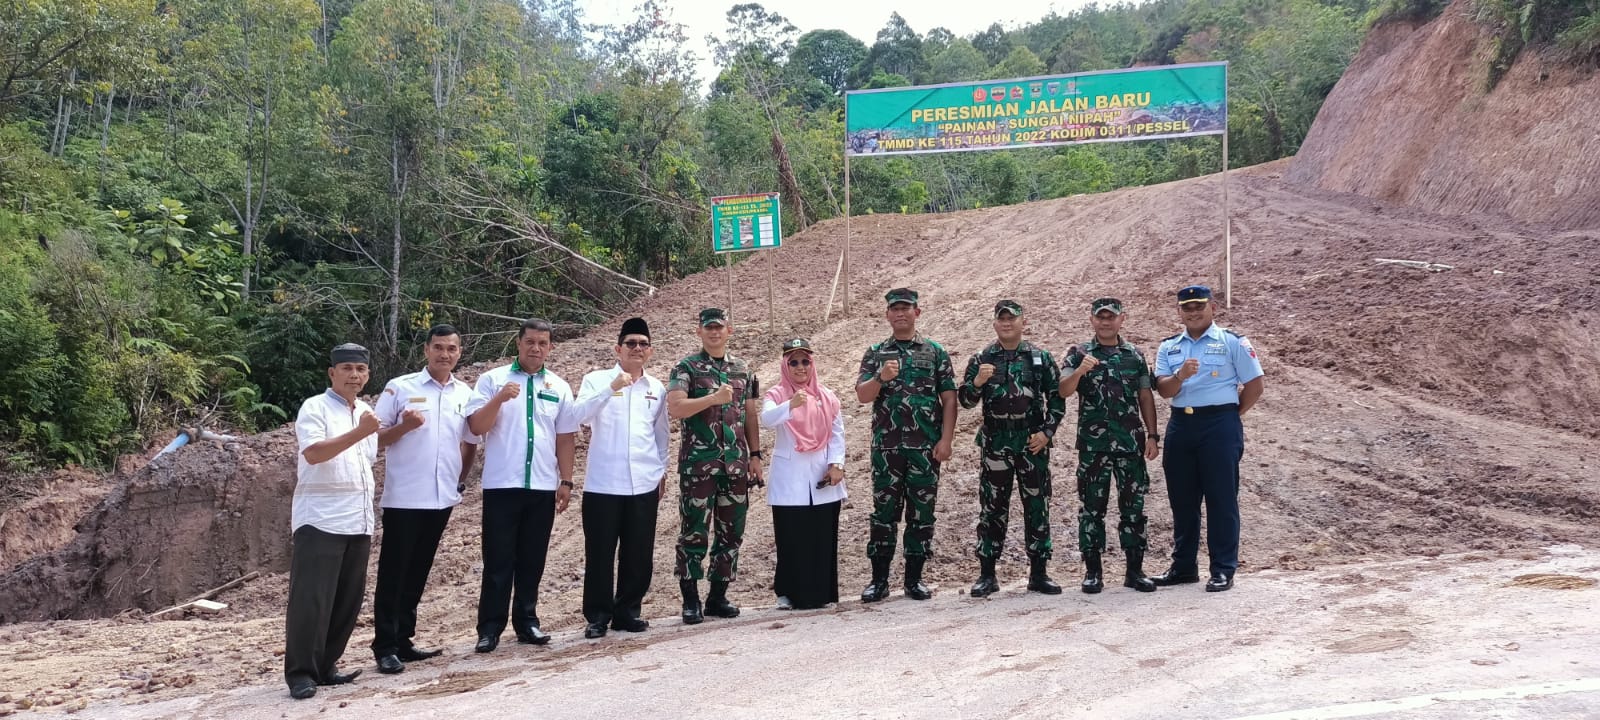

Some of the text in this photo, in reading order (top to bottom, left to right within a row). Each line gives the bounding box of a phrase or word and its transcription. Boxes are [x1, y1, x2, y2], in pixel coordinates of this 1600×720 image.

[911, 91, 1151, 122] PERESMIAN JALAN BARU
[1009, 114, 1064, 129] SUNGAI
[878, 137, 915, 150] TMMD
[918, 137, 936, 148] KE
[940, 136, 962, 146] 115
[965, 133, 1011, 145] TAHUN
[1015, 129, 1047, 142] 2022
[1050, 126, 1095, 140] KODIM
